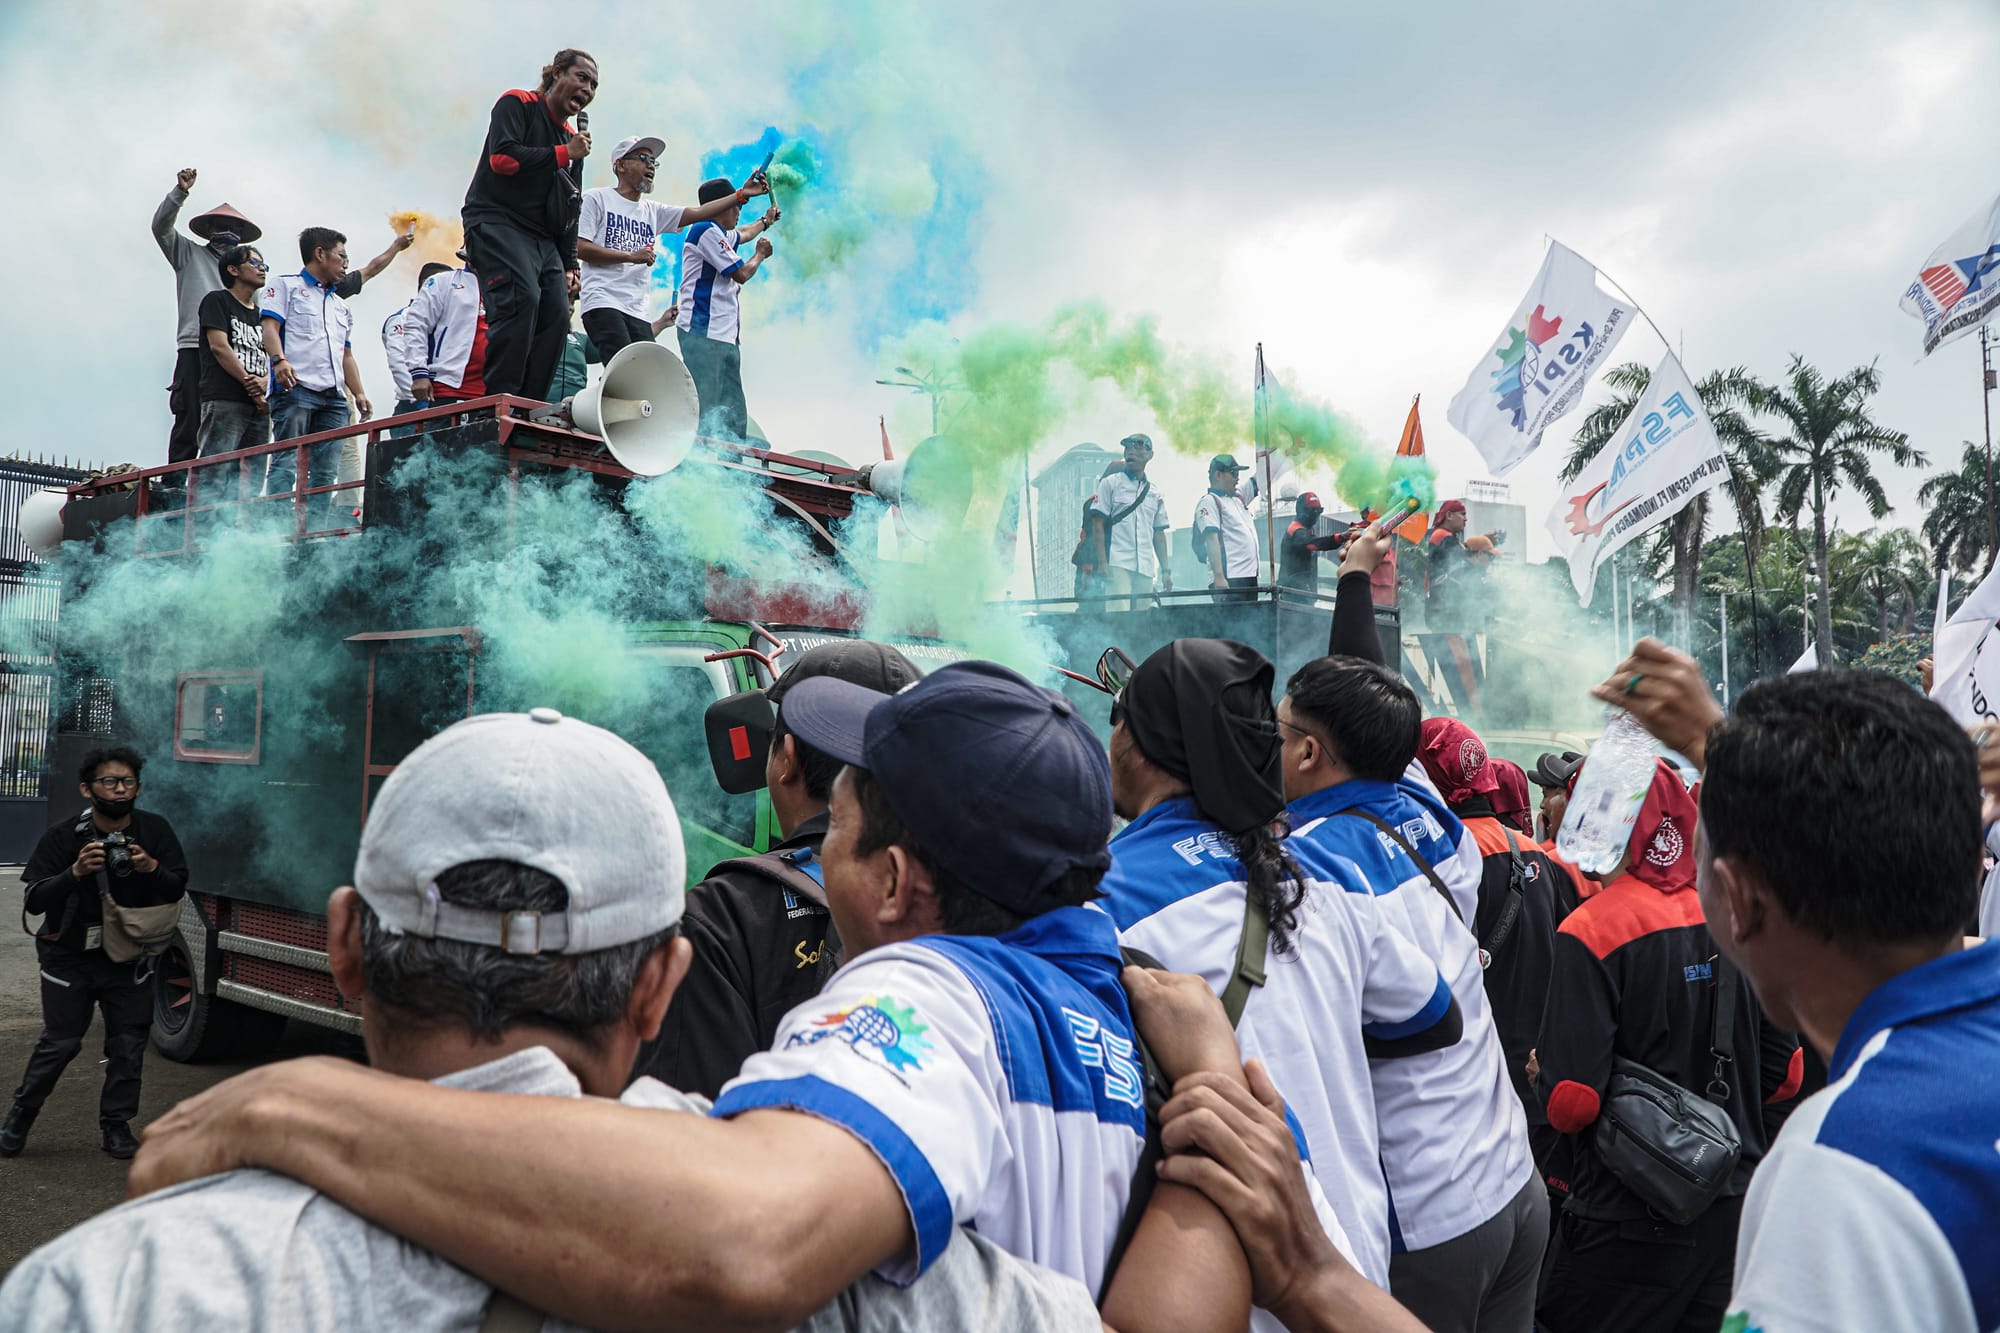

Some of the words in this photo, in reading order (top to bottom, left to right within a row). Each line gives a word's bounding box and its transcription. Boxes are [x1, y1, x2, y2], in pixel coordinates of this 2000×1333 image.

[606, 211, 654, 238] BANGGA
[605, 227, 656, 245] BERJUANG
[781, 638, 798, 652] PT
